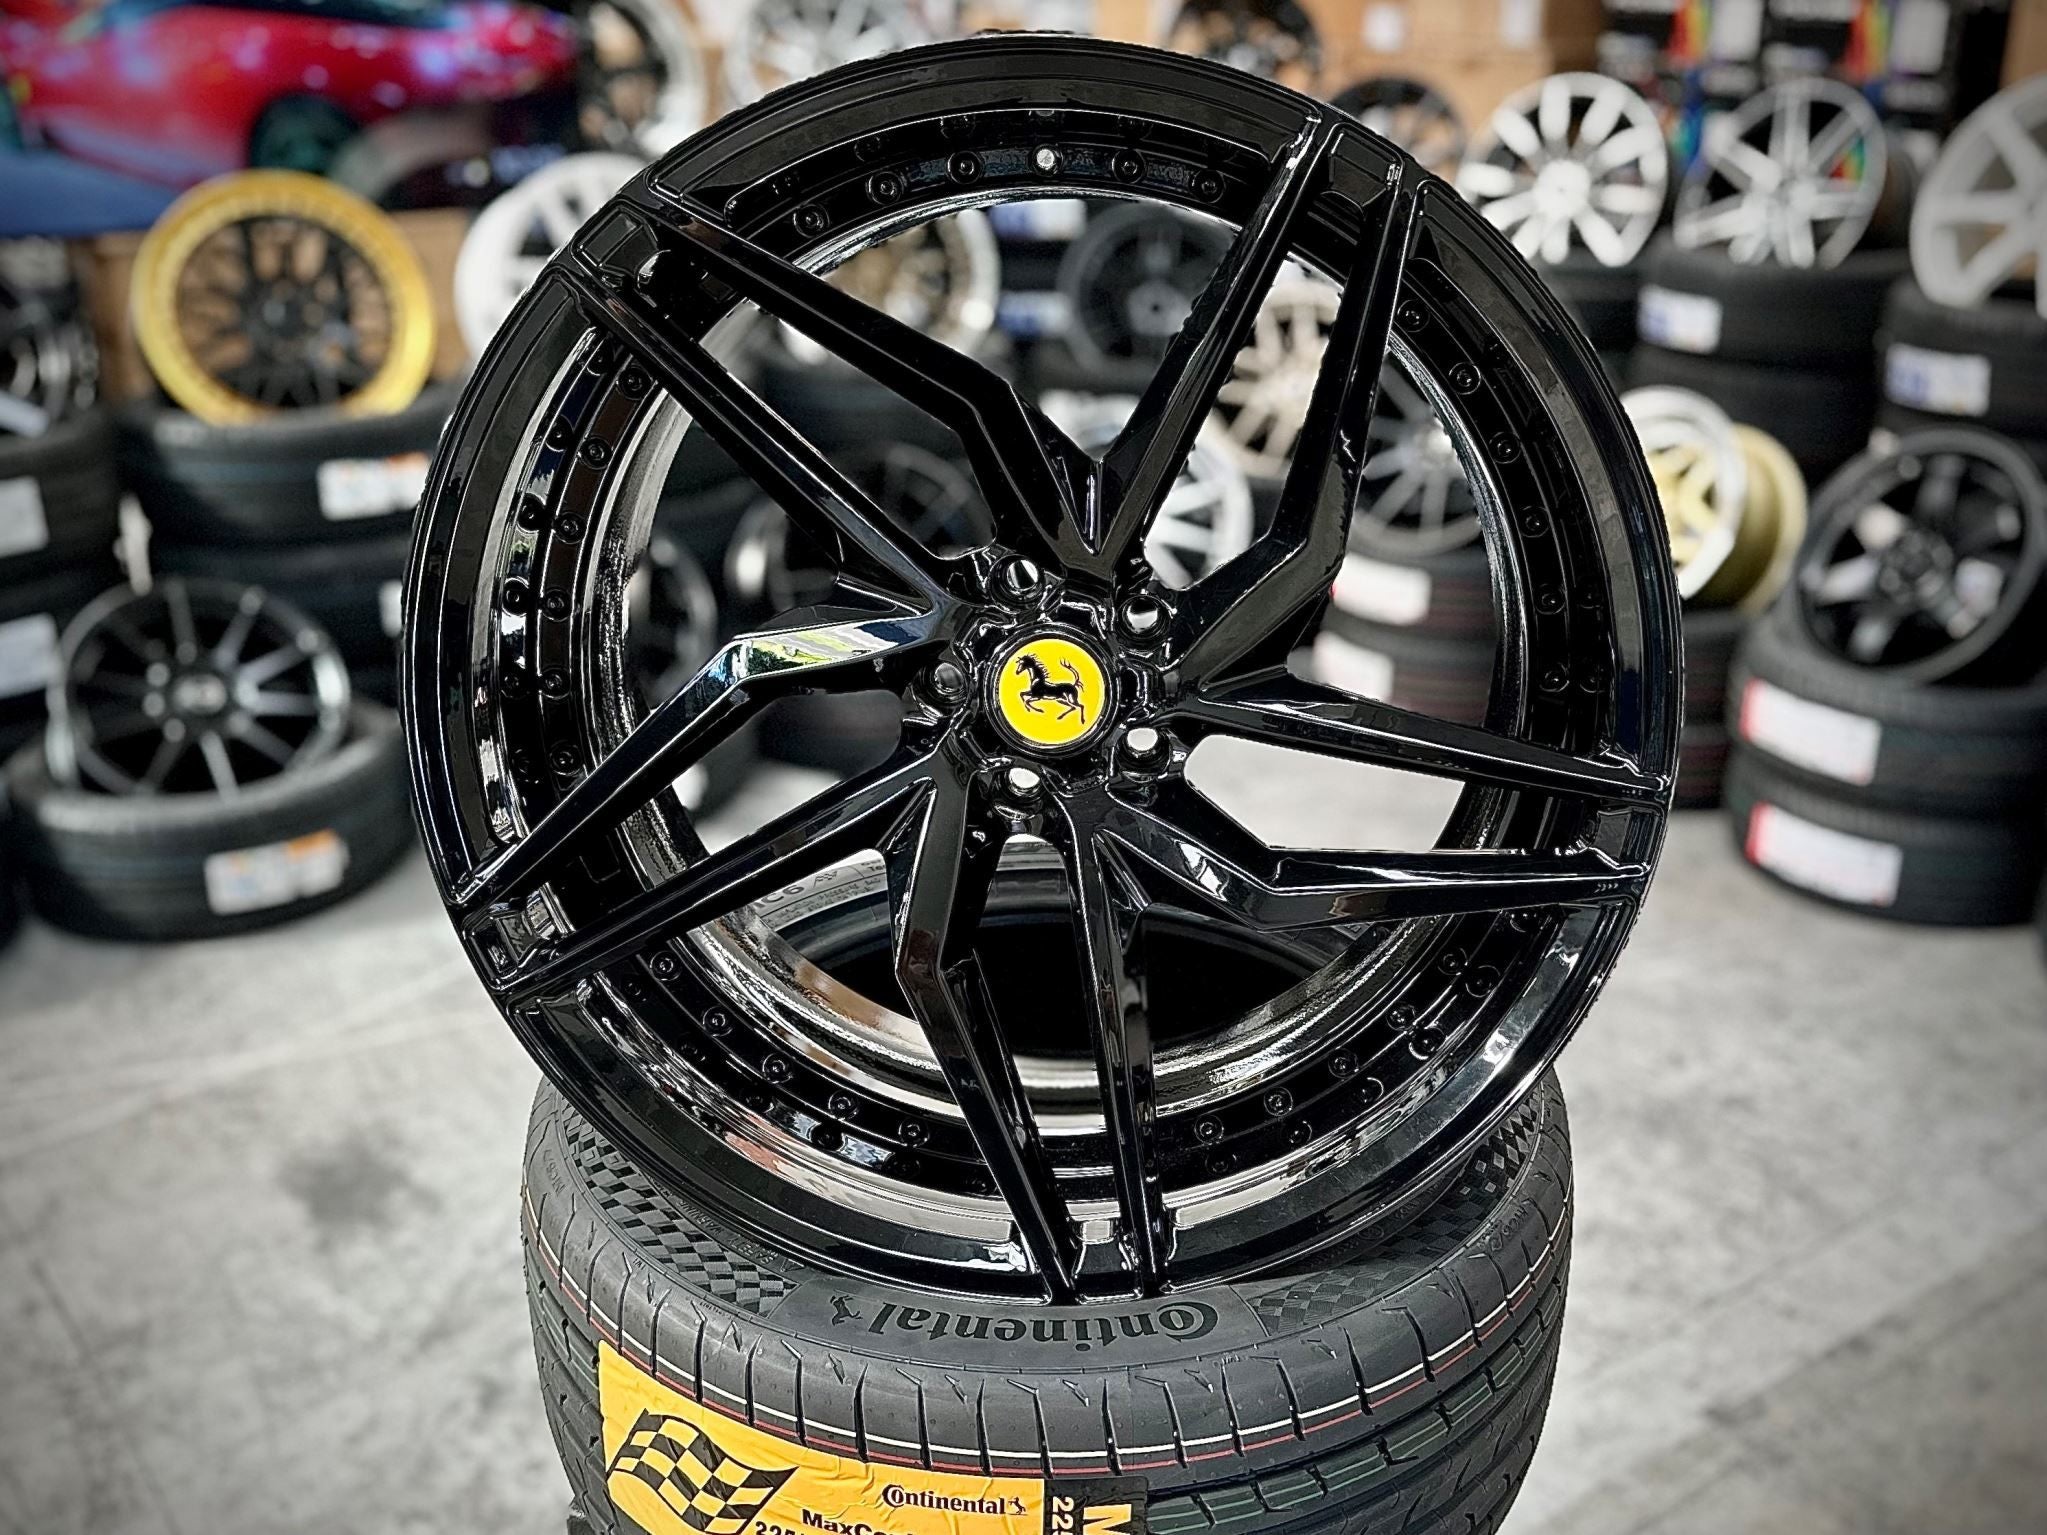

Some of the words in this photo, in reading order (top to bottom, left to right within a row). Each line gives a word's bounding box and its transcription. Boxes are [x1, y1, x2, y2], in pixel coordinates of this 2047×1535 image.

[867, 1300, 1219, 1352] Continental
[881, 1484, 1005, 1515] Continental
[1051, 1495, 1075, 1535] 22
